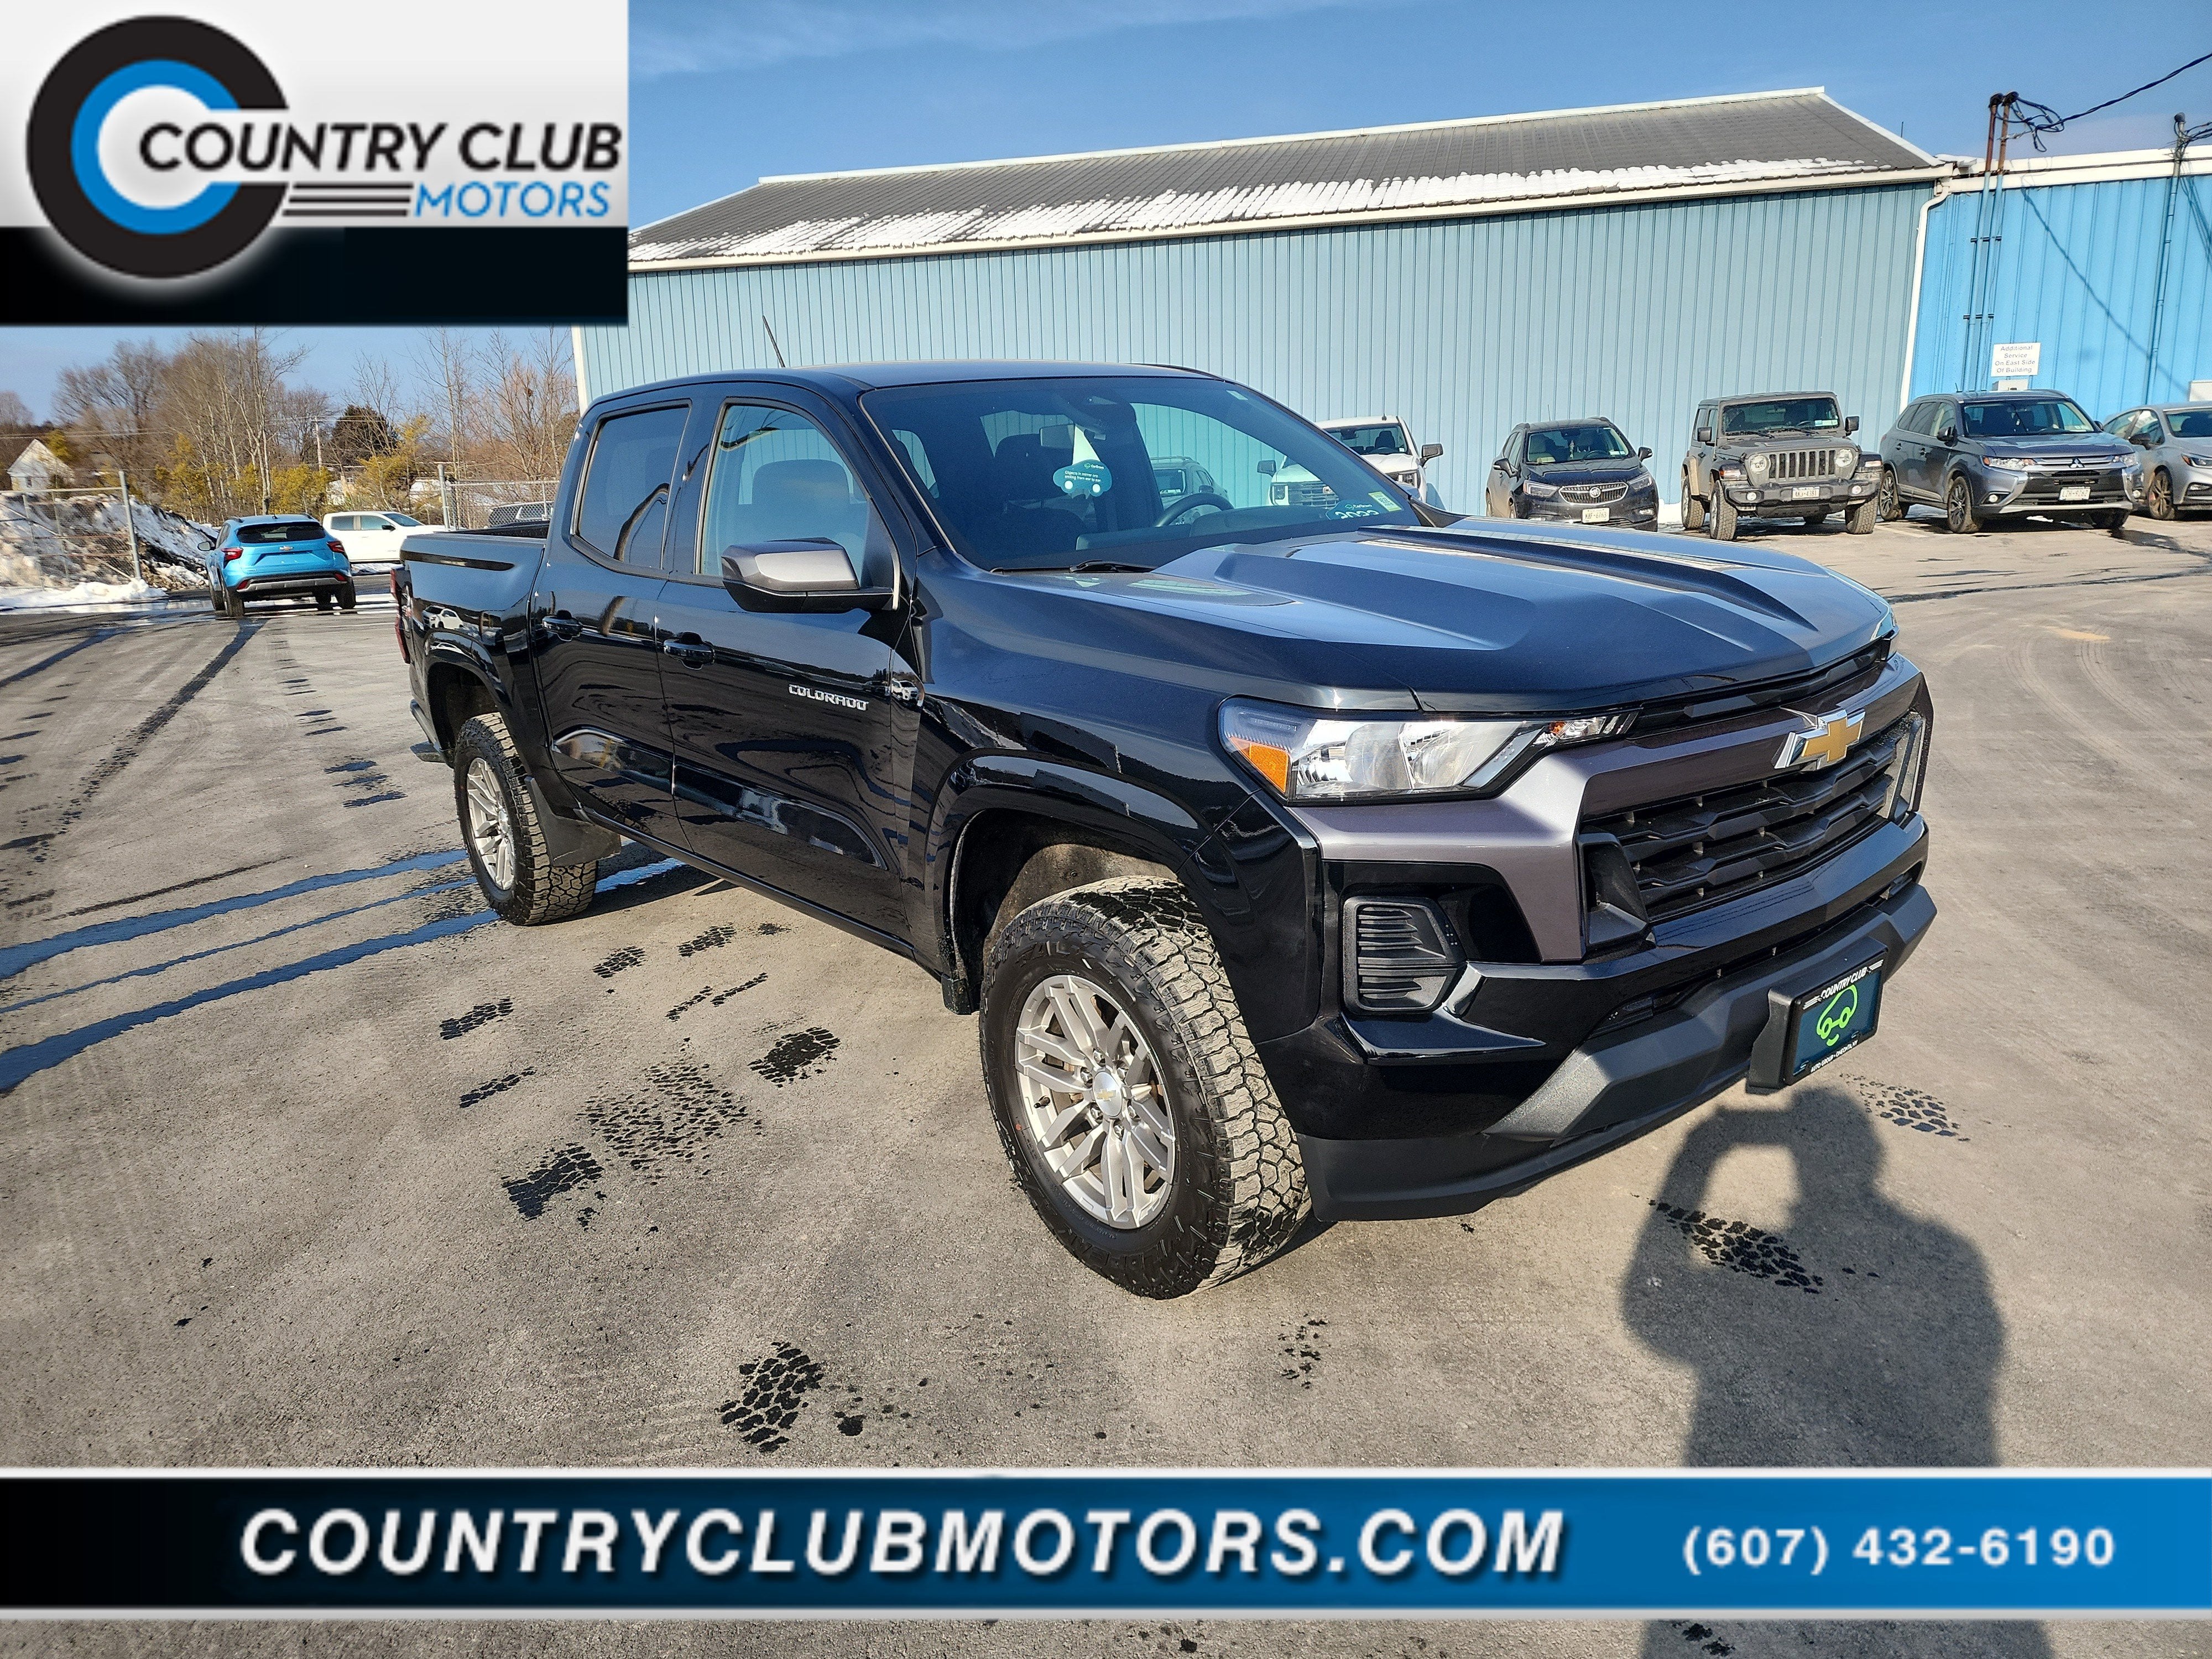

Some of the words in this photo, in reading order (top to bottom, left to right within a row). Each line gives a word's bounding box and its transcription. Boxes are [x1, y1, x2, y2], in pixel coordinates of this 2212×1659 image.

[788, 684, 869, 711] COLORADO
[1820, 975, 1852, 999] COUNTRY
[1850, 967, 1867, 983] CLUB
[1811, 1062, 1821, 1073] AUTO
[1821, 1054, 1834, 1066] GROUP
